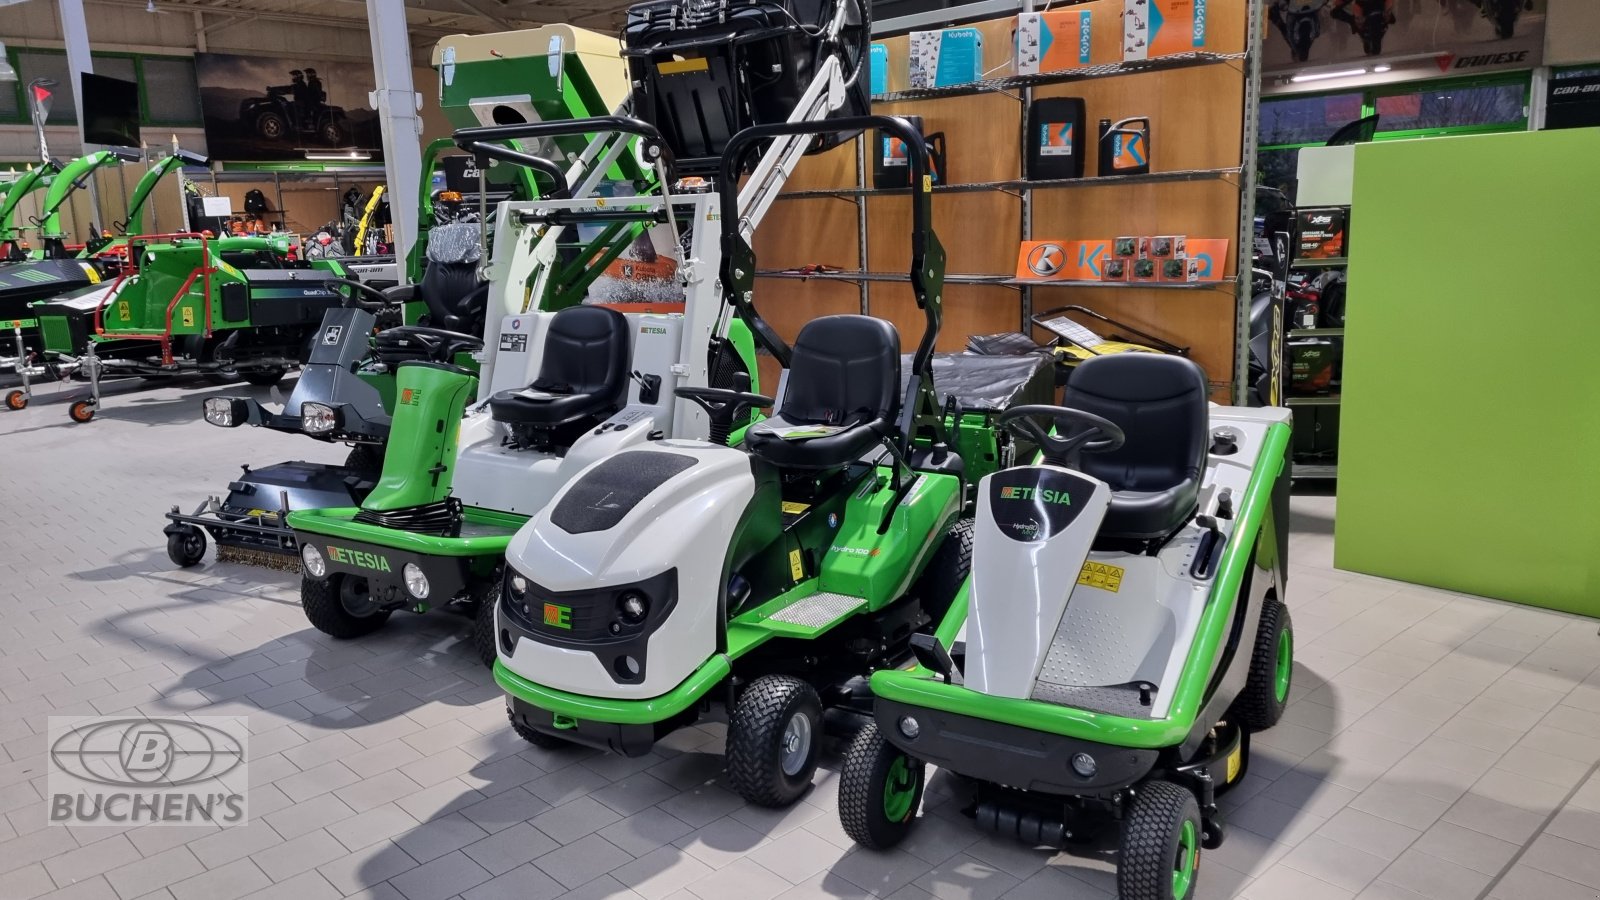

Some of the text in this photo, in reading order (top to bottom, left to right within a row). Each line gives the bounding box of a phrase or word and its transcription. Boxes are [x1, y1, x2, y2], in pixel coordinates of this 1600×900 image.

[1080, 18, 1090, 57] Kubota
[646, 326, 667, 335] ETESIA
[1009, 486, 1071, 506] ETESIA
[337, 547, 391, 573] ETESIA
